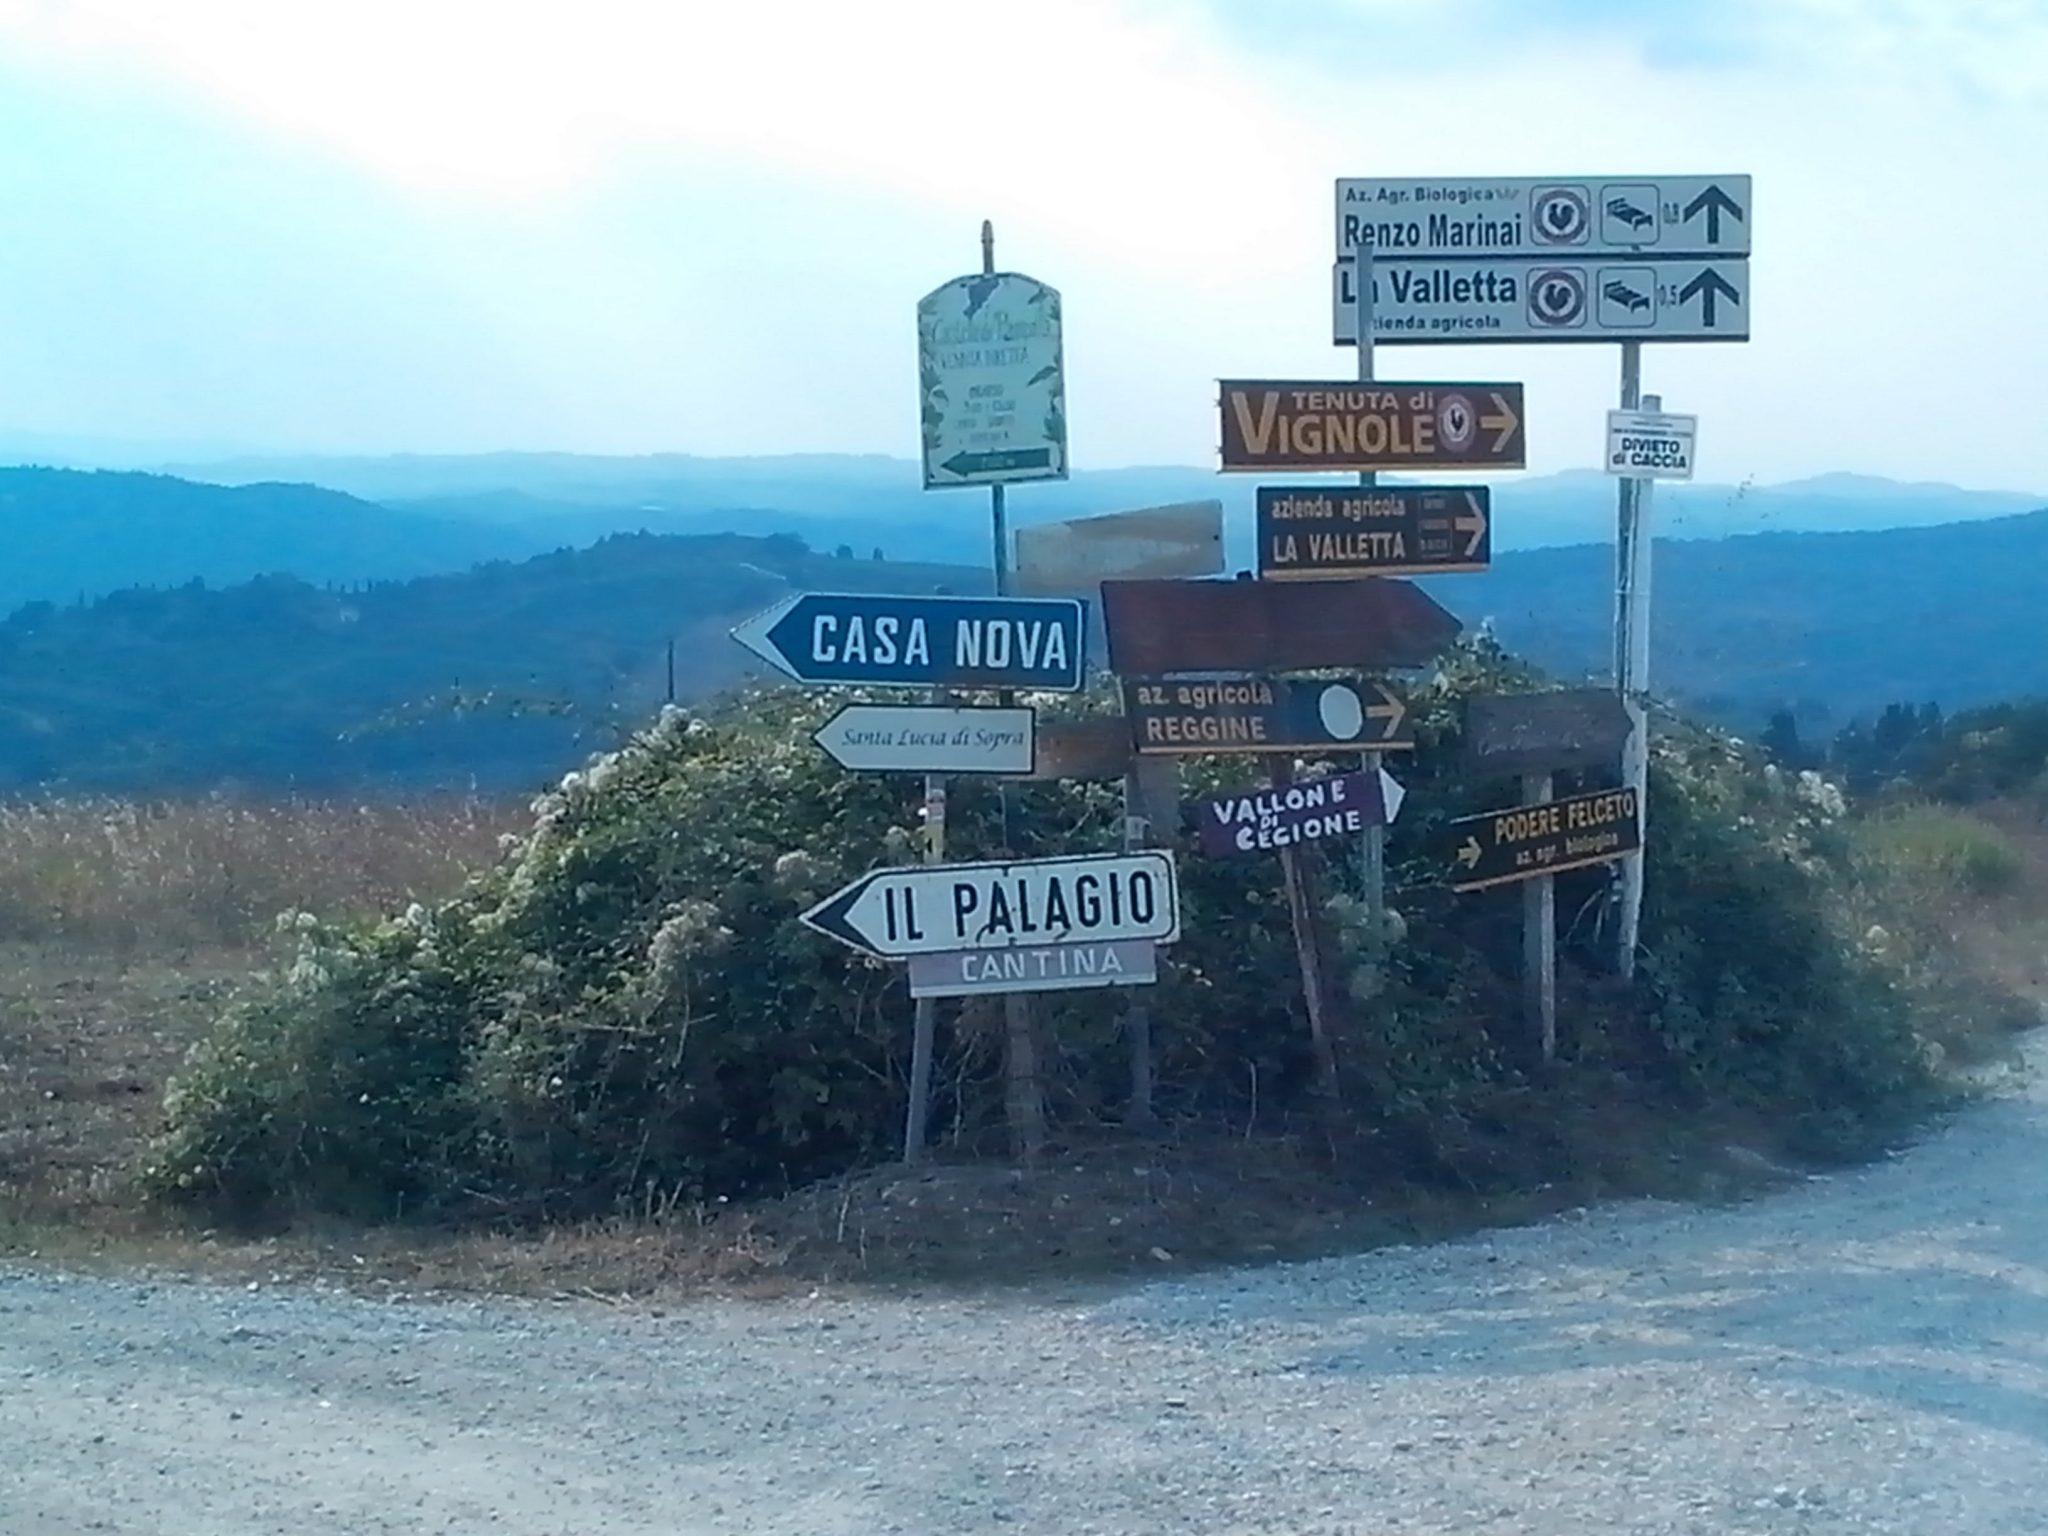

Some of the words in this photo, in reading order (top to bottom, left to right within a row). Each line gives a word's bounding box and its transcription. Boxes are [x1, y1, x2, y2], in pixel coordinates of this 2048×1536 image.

[1345, 187, 1372, 202] Az.
[1377, 187, 1410, 205] Agr.
[1415, 186, 1494, 205] Biologica
[1344, 213, 1420, 248] Renzo
[1429, 212, 1522, 247] Marinai
[1341, 270, 1379, 304] L
[1390, 269, 1517, 304] Valletta
[1431, 315, 1500, 332] agricola
[1291, 392, 1399, 410] TENUTA
[1409, 391, 1434, 410] di
[1231, 391, 1435, 455] VIGNOLE
[1622, 437, 1680, 454] DIVIETO
[1612, 452, 1626, 465] di
[1631, 452, 1687, 469] CACCIA
[1271, 494, 1333, 519] azienda
[1342, 494, 1406, 521] agricola
[1272, 534, 1298, 563] LA
[1309, 531, 1406, 560] VALLETTA
[812, 615, 929, 666] CASA
[956, 619, 1067, 670] NOVA
[1137, 686, 1170, 705] az.
[1177, 681, 1273, 709] agricola
[841, 729, 893, 747] Santa
[897, 729, 946, 747] Lucia
[951, 726, 969, 747] di
[973, 729, 1025, 752] Sopra
[1147, 716, 1267, 742] REGGINE
[1213, 779, 1346, 825] VALLONE
[1260, 814, 1278, 830] DI
[1495, 807, 1560, 845] PODERE
[1568, 793, 1633, 829] FELCETO
[886, 886, 923, 941] IL
[953, 871, 1154, 938] PALAGIO
[962, 947, 1123, 982] CANTINA
